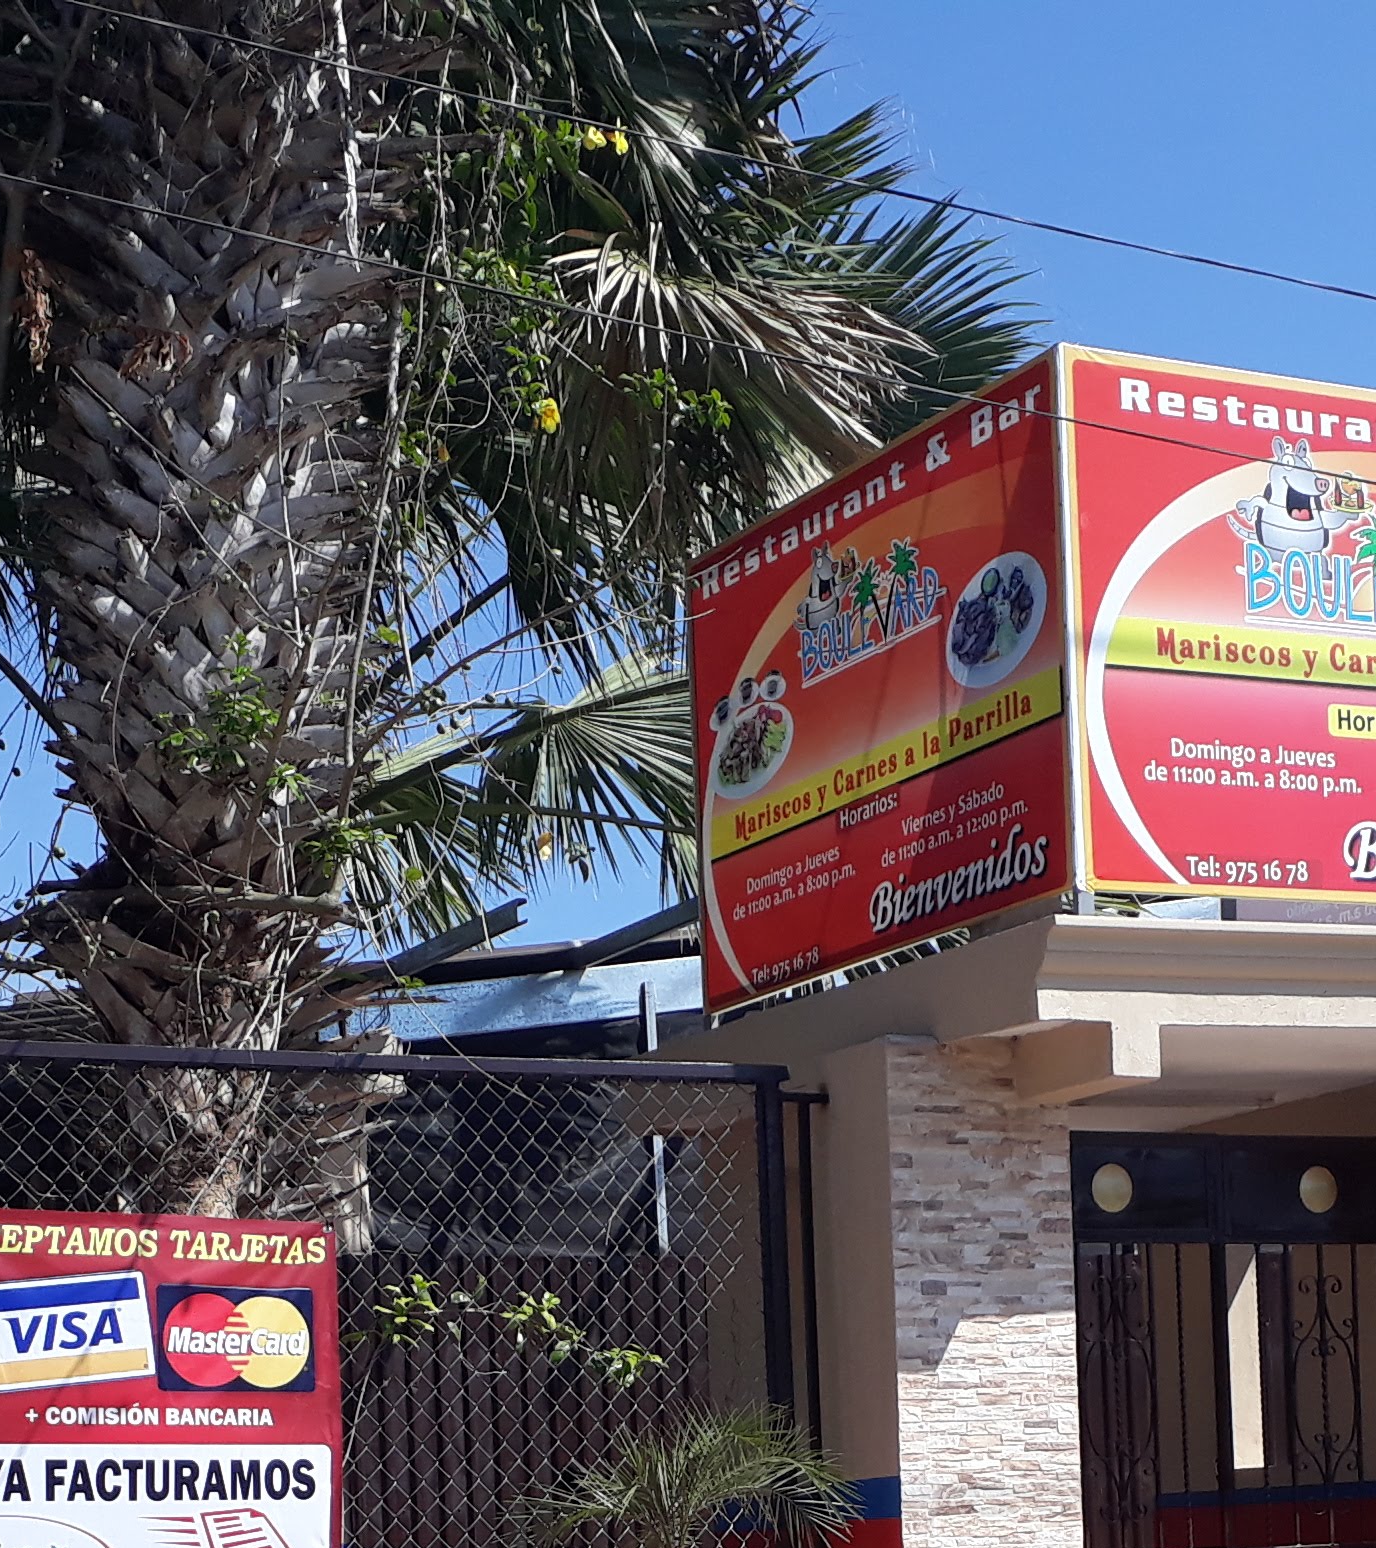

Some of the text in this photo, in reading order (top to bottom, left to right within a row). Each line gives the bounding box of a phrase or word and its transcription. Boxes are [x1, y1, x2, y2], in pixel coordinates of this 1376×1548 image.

[701, 384, 1042, 600] Restaurant & Bar
[801, 566, 940, 680] BOULEVARD
[1156, 627, 1292, 668] Mariscos
[1302, 648, 1319, 678] y
[735, 690, 1032, 842] Mariscos y Carnes a la Parrilla
[1170, 737, 1337, 768] Domingo a Jueves
[1144, 759, 1362, 797] de 11:00 a.m. a 8:00 p.m.
[839, 792, 898, 830] Horarios:
[901, 781, 1005, 836] Viernes y Sábado
[881, 800, 1029, 868] de 11:00 a.m. a 12:00 p.m.
[733, 863, 856, 921] de 11:00 a.m. a 8:00 p.m.
[746, 846, 841, 895] Domingo a Jueves
[869, 823, 1048, 933] Bienvenidos
[1185, 855, 1309, 885] Tel: 975 16 78
[751, 946, 820, 985] Tel: 975 16 78
[170, 1230, 326, 1265] TARJETAS
[2, 1306, 124, 1354] VISA
[168, 1326, 308, 1357] MasterCard
[25, 1403, 274, 1427] + COMISIÓN BANCARIA
[45, 1458, 317, 1502] FACTURAMOS
